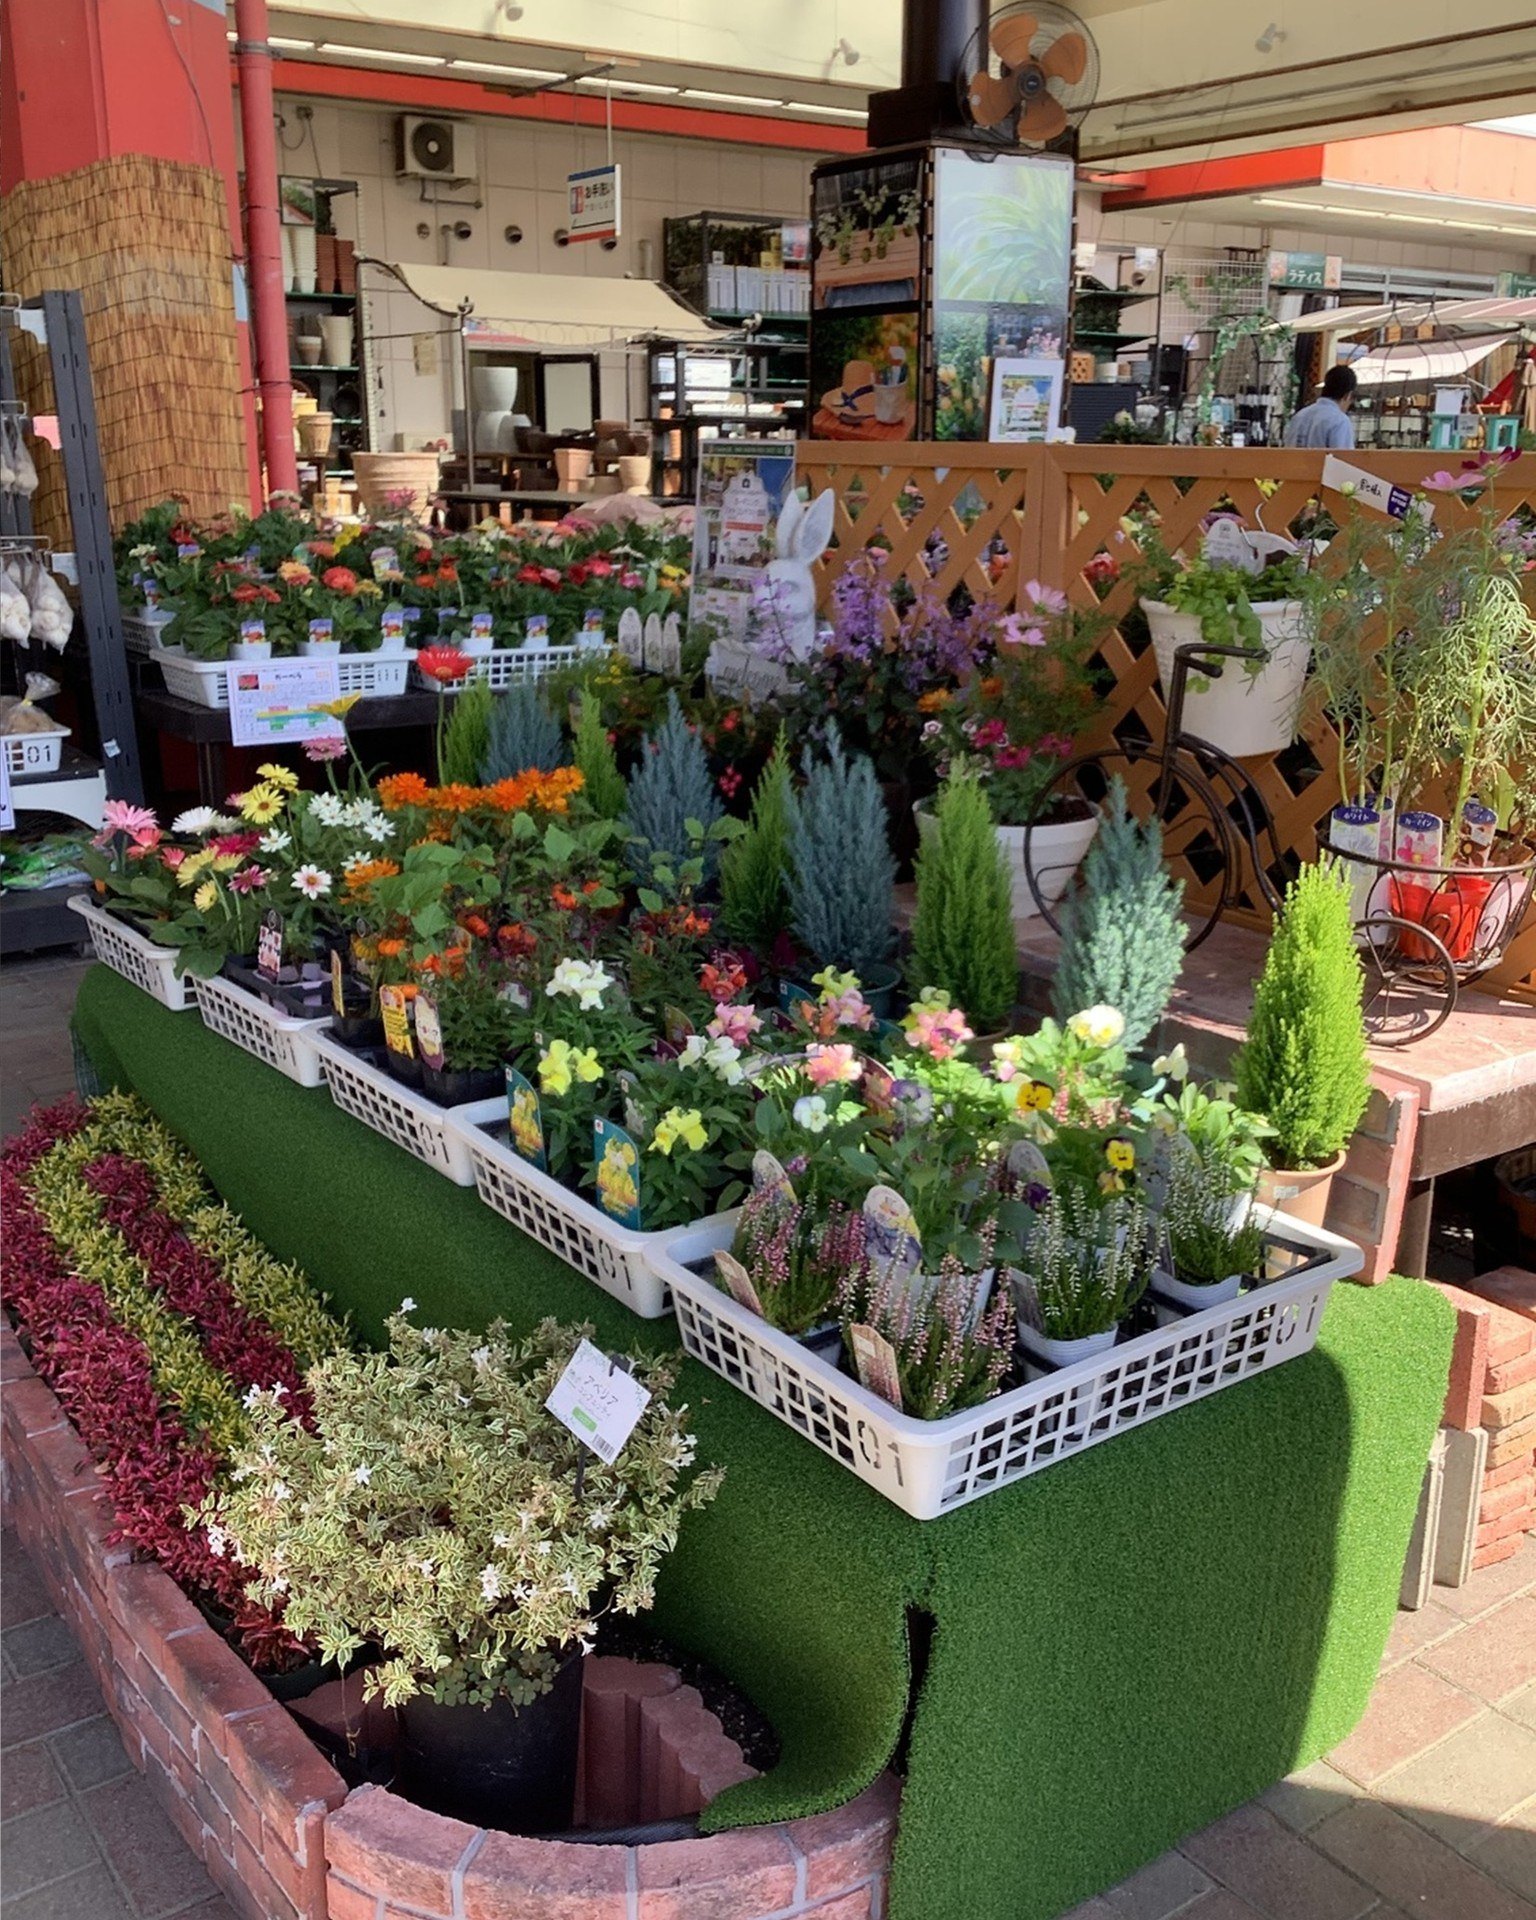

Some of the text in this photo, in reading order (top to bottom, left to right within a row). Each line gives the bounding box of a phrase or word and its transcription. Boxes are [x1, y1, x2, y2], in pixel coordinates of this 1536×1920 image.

[1288, 269, 1322, 284] ラティス
[27, 745, 51, 763] 01
[1343, 812, 1370, 821] ホワイト
[419, 1122, 450, 1164] 01
[600, 1238, 632, 1291] 01
[857, 1420, 904, 1487] 01
